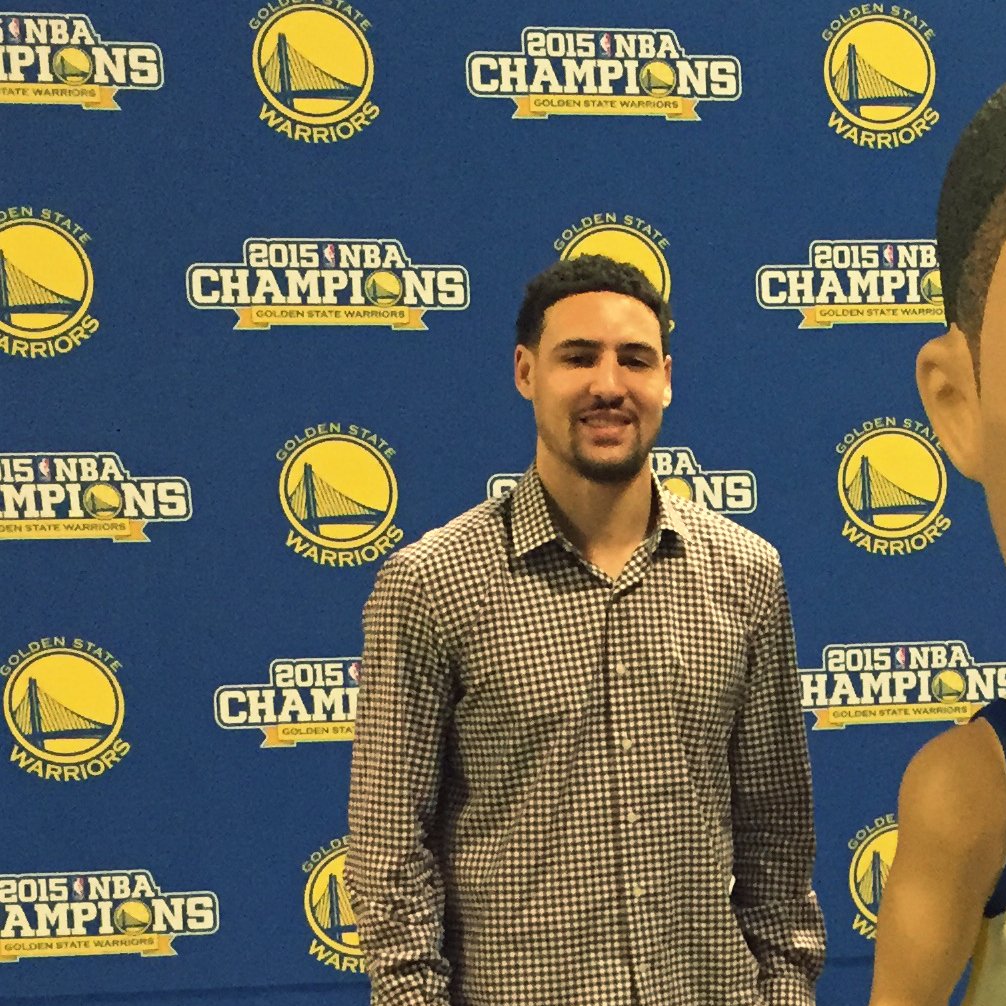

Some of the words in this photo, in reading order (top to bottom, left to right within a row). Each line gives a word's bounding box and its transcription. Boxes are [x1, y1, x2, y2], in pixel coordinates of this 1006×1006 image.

[25, 19, 95, 44] NBA
[822, 3, 883, 41] GOLDEN
[891, 5, 936, 41] STATE
[528, 32, 595, 57] 2015
[615, 35, 679, 58] NBA
[471, 58, 737, 95] CHAMPIONS
[33, 89, 96, 98] WARRIORS
[534, 99, 581, 108] GOLDEN
[583, 100, 616, 108] STATE
[620, 101, 678, 109] WARRIORS
[259, 102, 380, 144] WARRIORS
[828, 108, 940, 149] WARRIORS
[42, 209, 92, 245] STATE
[553, 213, 616, 250] GOLDEN
[624, 215, 670, 250] STATE
[249, 244, 319, 268] 2015
[339, 245, 405, 268] NBA
[814, 246, 879, 269] 2015
[192, 270, 465, 305] CHAMPIONS
[256, 310, 304, 318] GOLDEN
[307, 311, 341, 319] STATE
[345, 311, 405, 319] WARRIORS
[820, 309, 864, 317] GOLDEN
[867, 309, 898, 317] STATE
[276, 423, 340, 461] GOLDEN
[348, 425, 397, 459] STATE
[836, 417, 896, 454] GOLDEN
[54, 458, 124, 482] NBA
[64, 524, 126, 532] WARRIORS
[842, 515, 951, 555] WARRIORS
[286, 525, 404, 567] WARRIORS
[0, 637, 65, 676] GOLDEN
[73, 638, 123, 672] STATE
[828, 648, 891, 672] 2015
[910, 646, 969, 669] NBA
[276, 663, 343, 688] 2015
[833, 709, 876, 719] GOLDEN
[879, 709, 910, 717] STATE
[913, 706, 967, 716] WARRIORS
[282, 727, 329, 736] GOLDEN
[10, 739, 131, 781] WARRIORS
[0, 878, 68, 903] 2015
[89, 875, 155, 900] NBA
[0, 896, 214, 938] AMPIONS
[5, 942, 53, 952] GOLDEN
[56, 941, 90, 950] STATE
[94, 938, 154, 948] WARRIORS
